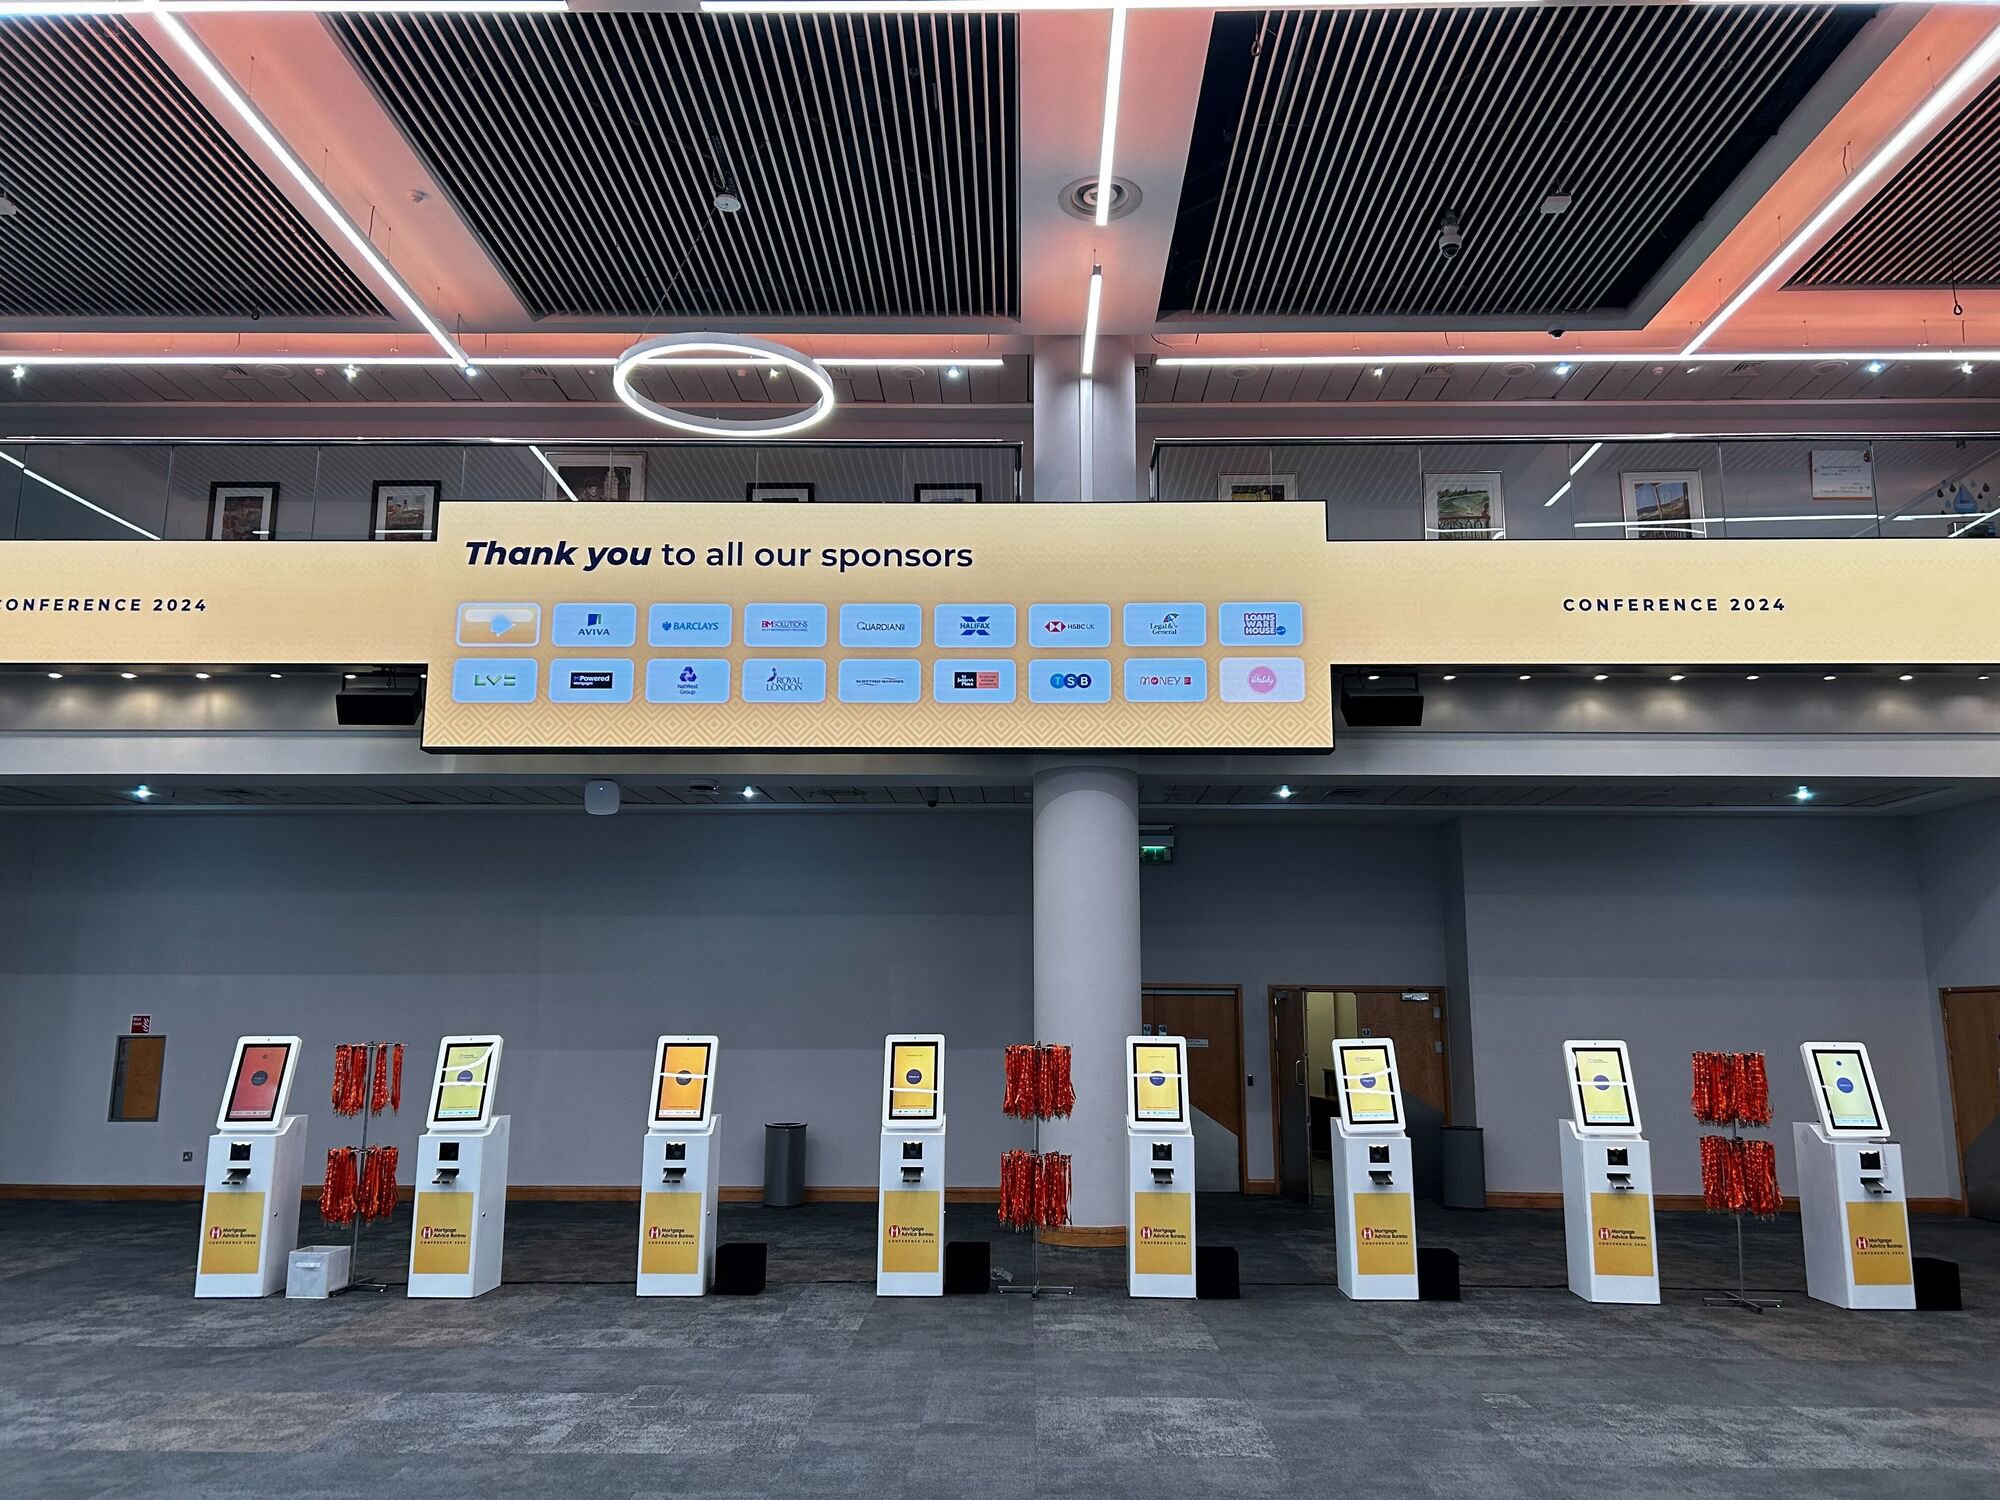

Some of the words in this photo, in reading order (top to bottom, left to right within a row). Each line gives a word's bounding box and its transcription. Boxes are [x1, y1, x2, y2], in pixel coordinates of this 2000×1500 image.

[466, 541, 578, 565] Thank
[583, 548, 652, 571] you
[662, 544, 695, 566] to
[706, 542, 743, 566] all
[754, 548, 811, 566] our
[821, 548, 973, 572] sponsors
[0, 598, 142, 611] ONFERENCE
[153, 598, 206, 611] 2024
[1563, 598, 1717, 611] CONFERENCE
[1730, 598, 1785, 611] 2024
[673, 622, 719, 631] BARCLAYS
[761, 620, 773, 628] BM
[774, 620, 808, 628] SOLUTIONS
[960, 622, 990, 630] HALIFAX
[1150, 623, 1168, 631] Legal
[578, 628, 610, 636] AVIVA
[1053, 676, 1090, 687] TSB
[766, 683, 803, 691] LONDON
